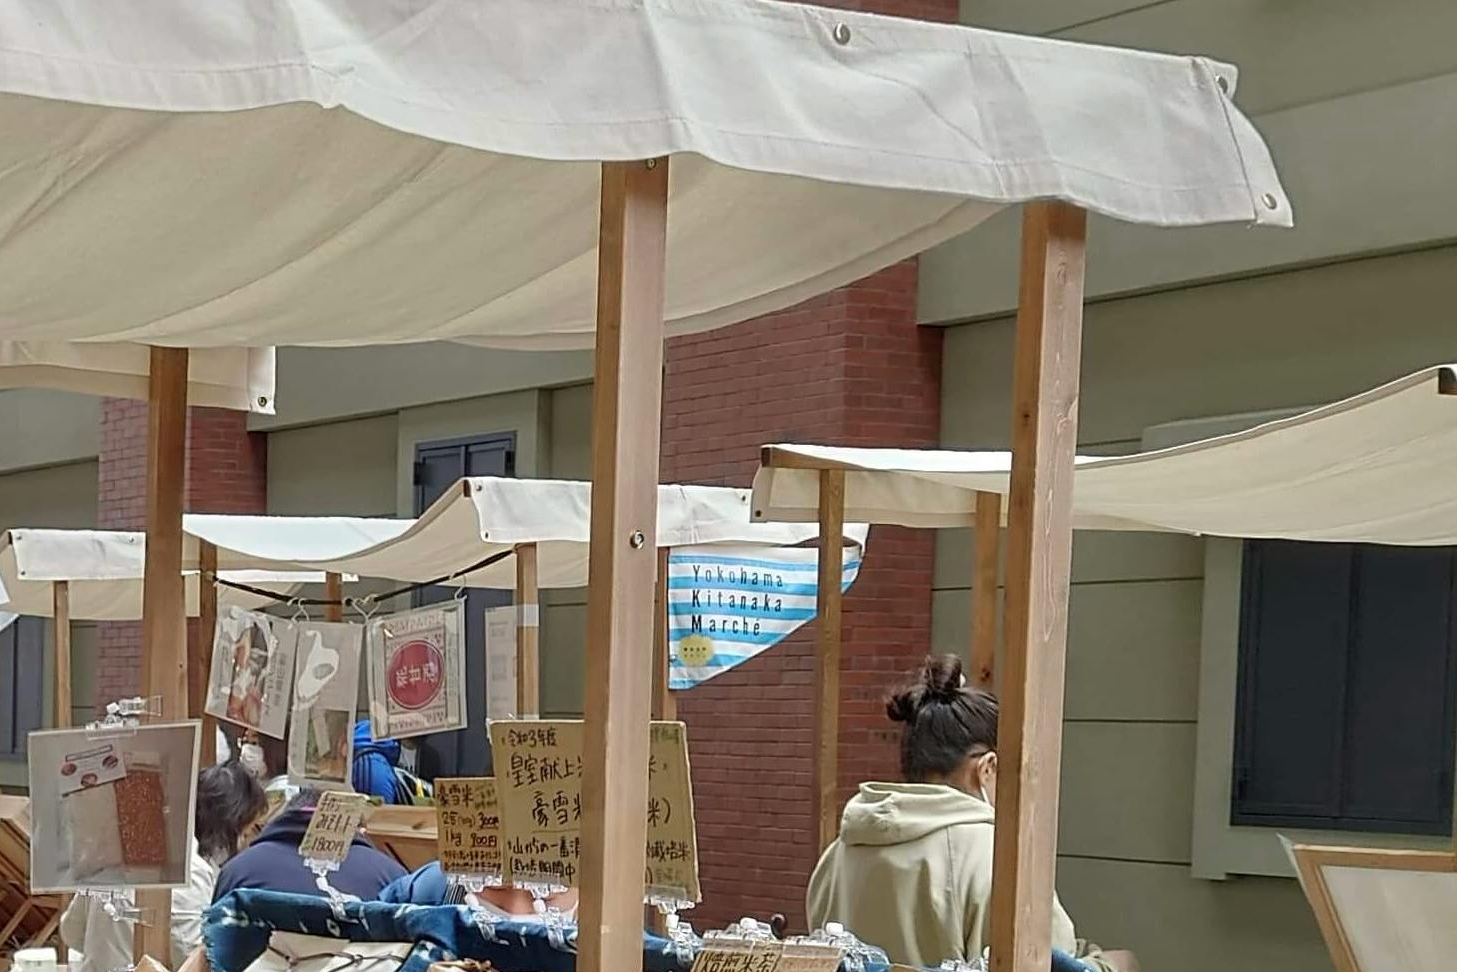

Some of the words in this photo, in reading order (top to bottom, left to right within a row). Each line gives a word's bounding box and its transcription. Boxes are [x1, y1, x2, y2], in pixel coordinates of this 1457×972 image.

[693, 565, 784, 588] Yokohama
[692, 590, 782, 612] Kitanaka
[691, 615, 761, 636] Marché
